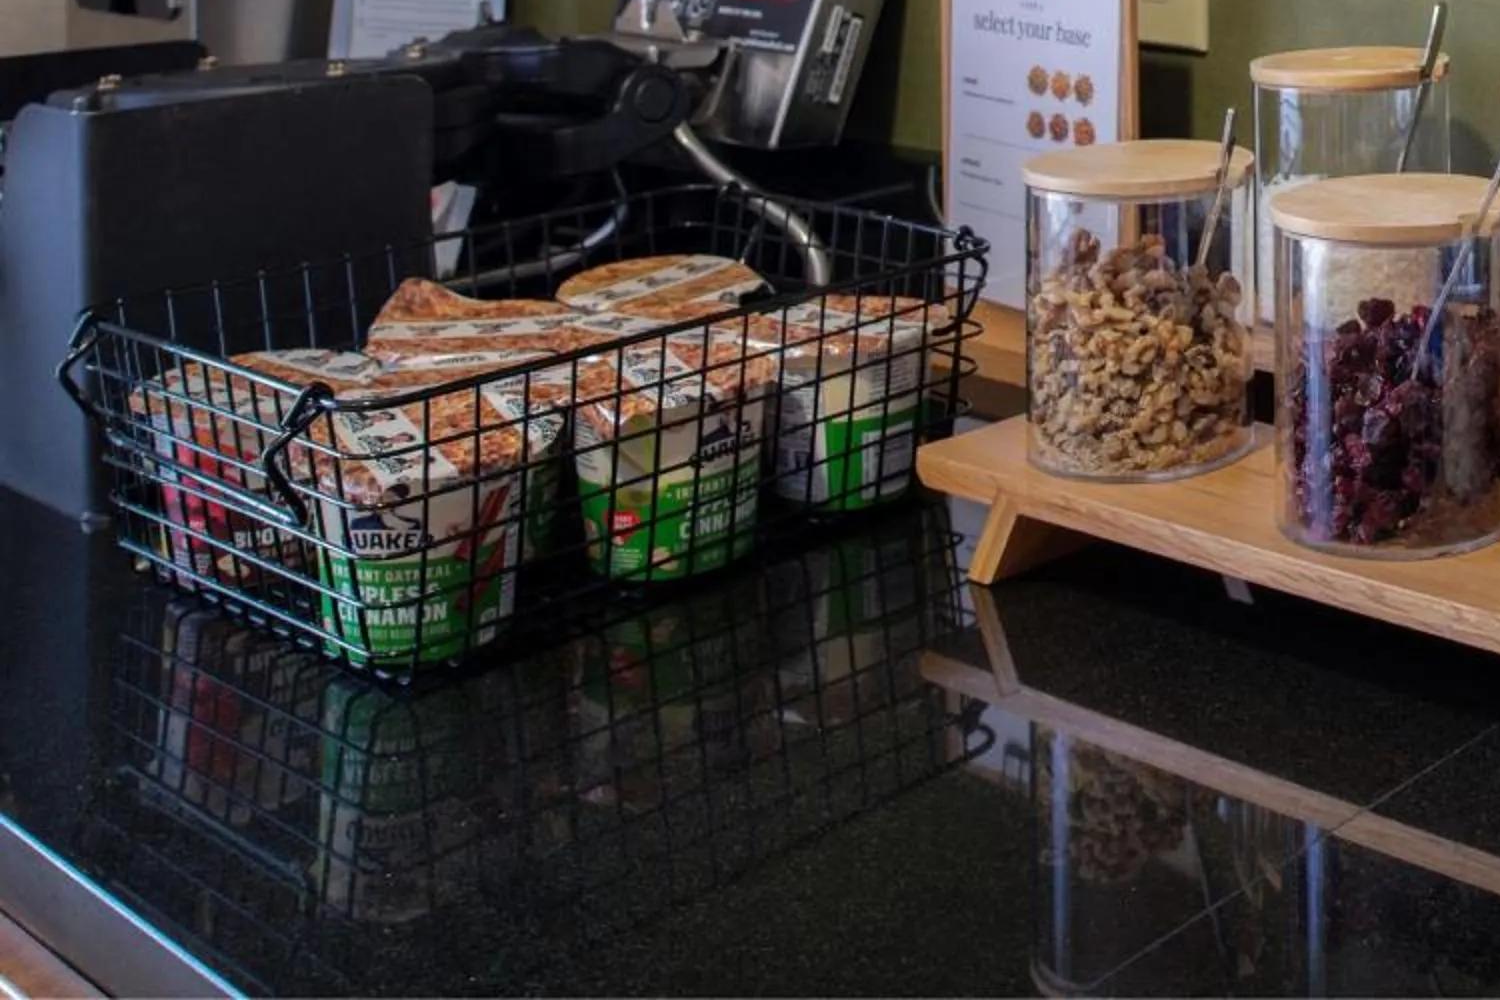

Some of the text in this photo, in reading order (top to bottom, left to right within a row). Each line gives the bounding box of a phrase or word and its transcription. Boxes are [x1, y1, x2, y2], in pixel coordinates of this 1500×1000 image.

[974, 10, 1092, 48] select your base
[347, 532, 434, 552] UAKE
[338, 600, 448, 627] CINAMN
